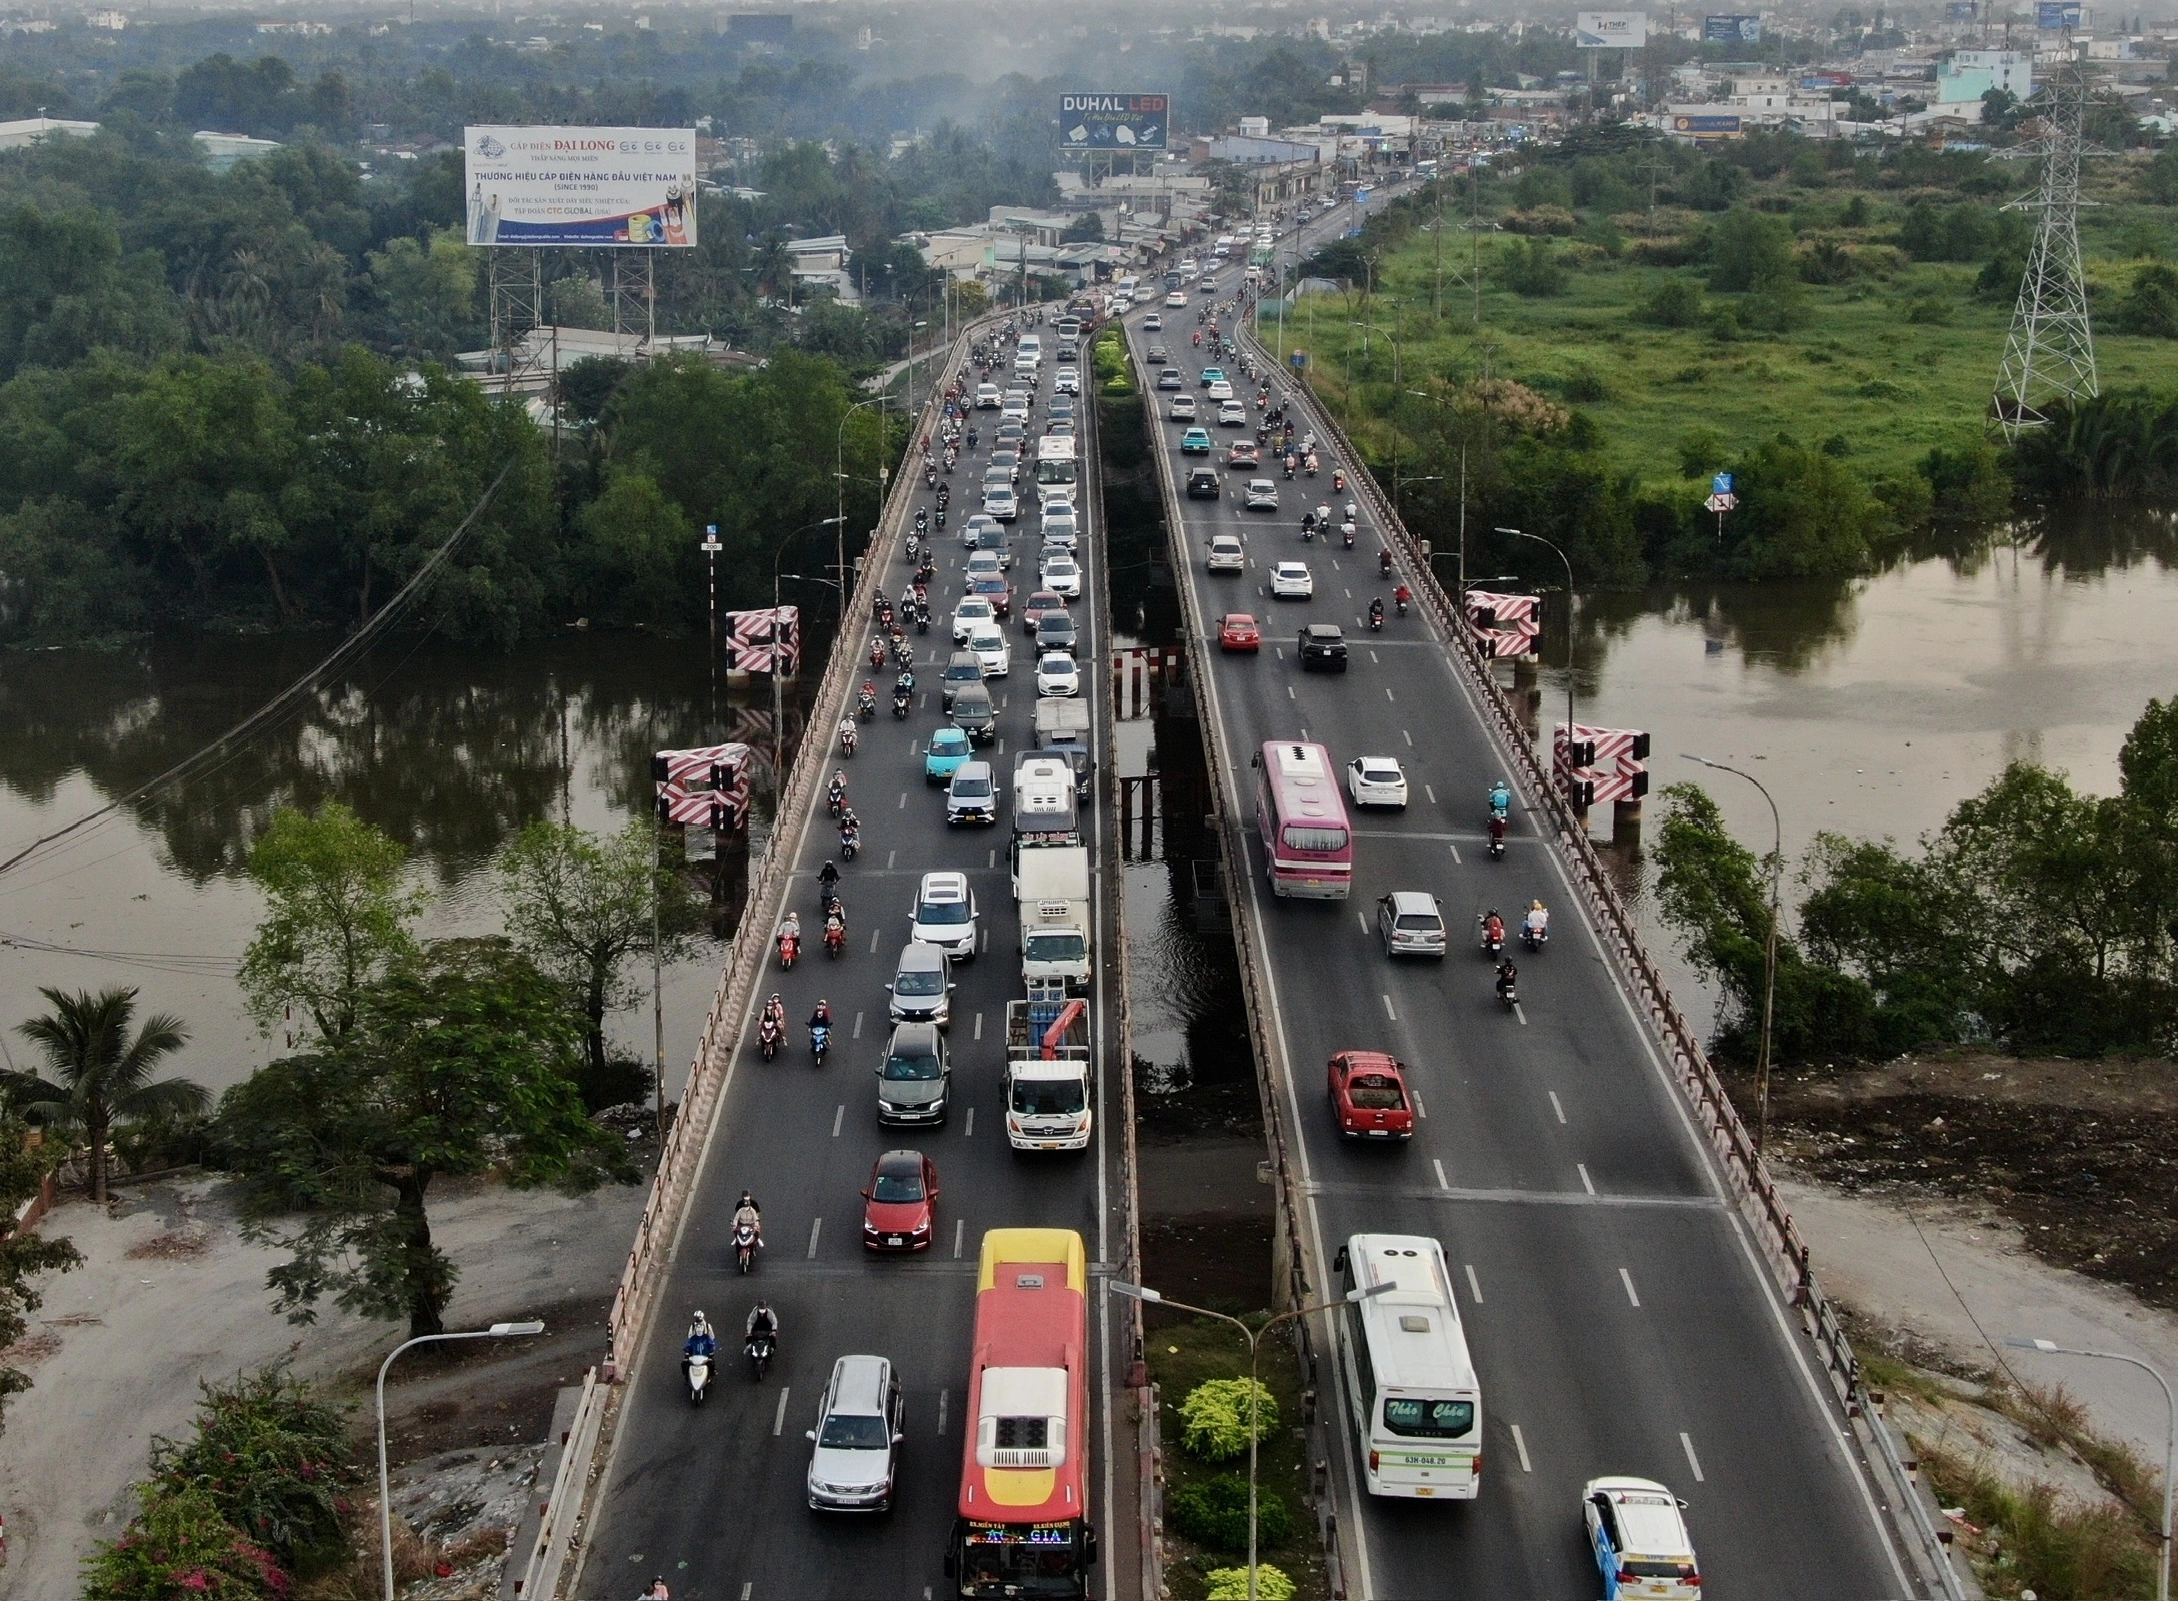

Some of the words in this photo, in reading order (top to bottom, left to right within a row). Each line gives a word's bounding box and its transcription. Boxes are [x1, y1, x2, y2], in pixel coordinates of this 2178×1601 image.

[1063, 96, 1124, 111] DUHAL
[1129, 97, 1164, 112] LED
[554, 139, 577, 153] ĐẠI
[580, 140, 615, 151] LONG
[474, 171, 513, 181] THƯƠNG
[515, 171, 537, 182] HIỆU
[539, 171, 557, 181] CÁP
[559, 171, 580, 183] ĐIỆN
[583, 171, 609, 182] HÀNG
[611, 170, 631, 182] ĐẦU
[633, 171, 653, 183] VIỆT
[655, 174, 677, 182] NAM
[554, 183, 578, 191] (SINCE
[579, 183, 599, 191] 1990)
[546, 207, 563, 215] CTC
[563, 207, 594, 215] GLOBAL
